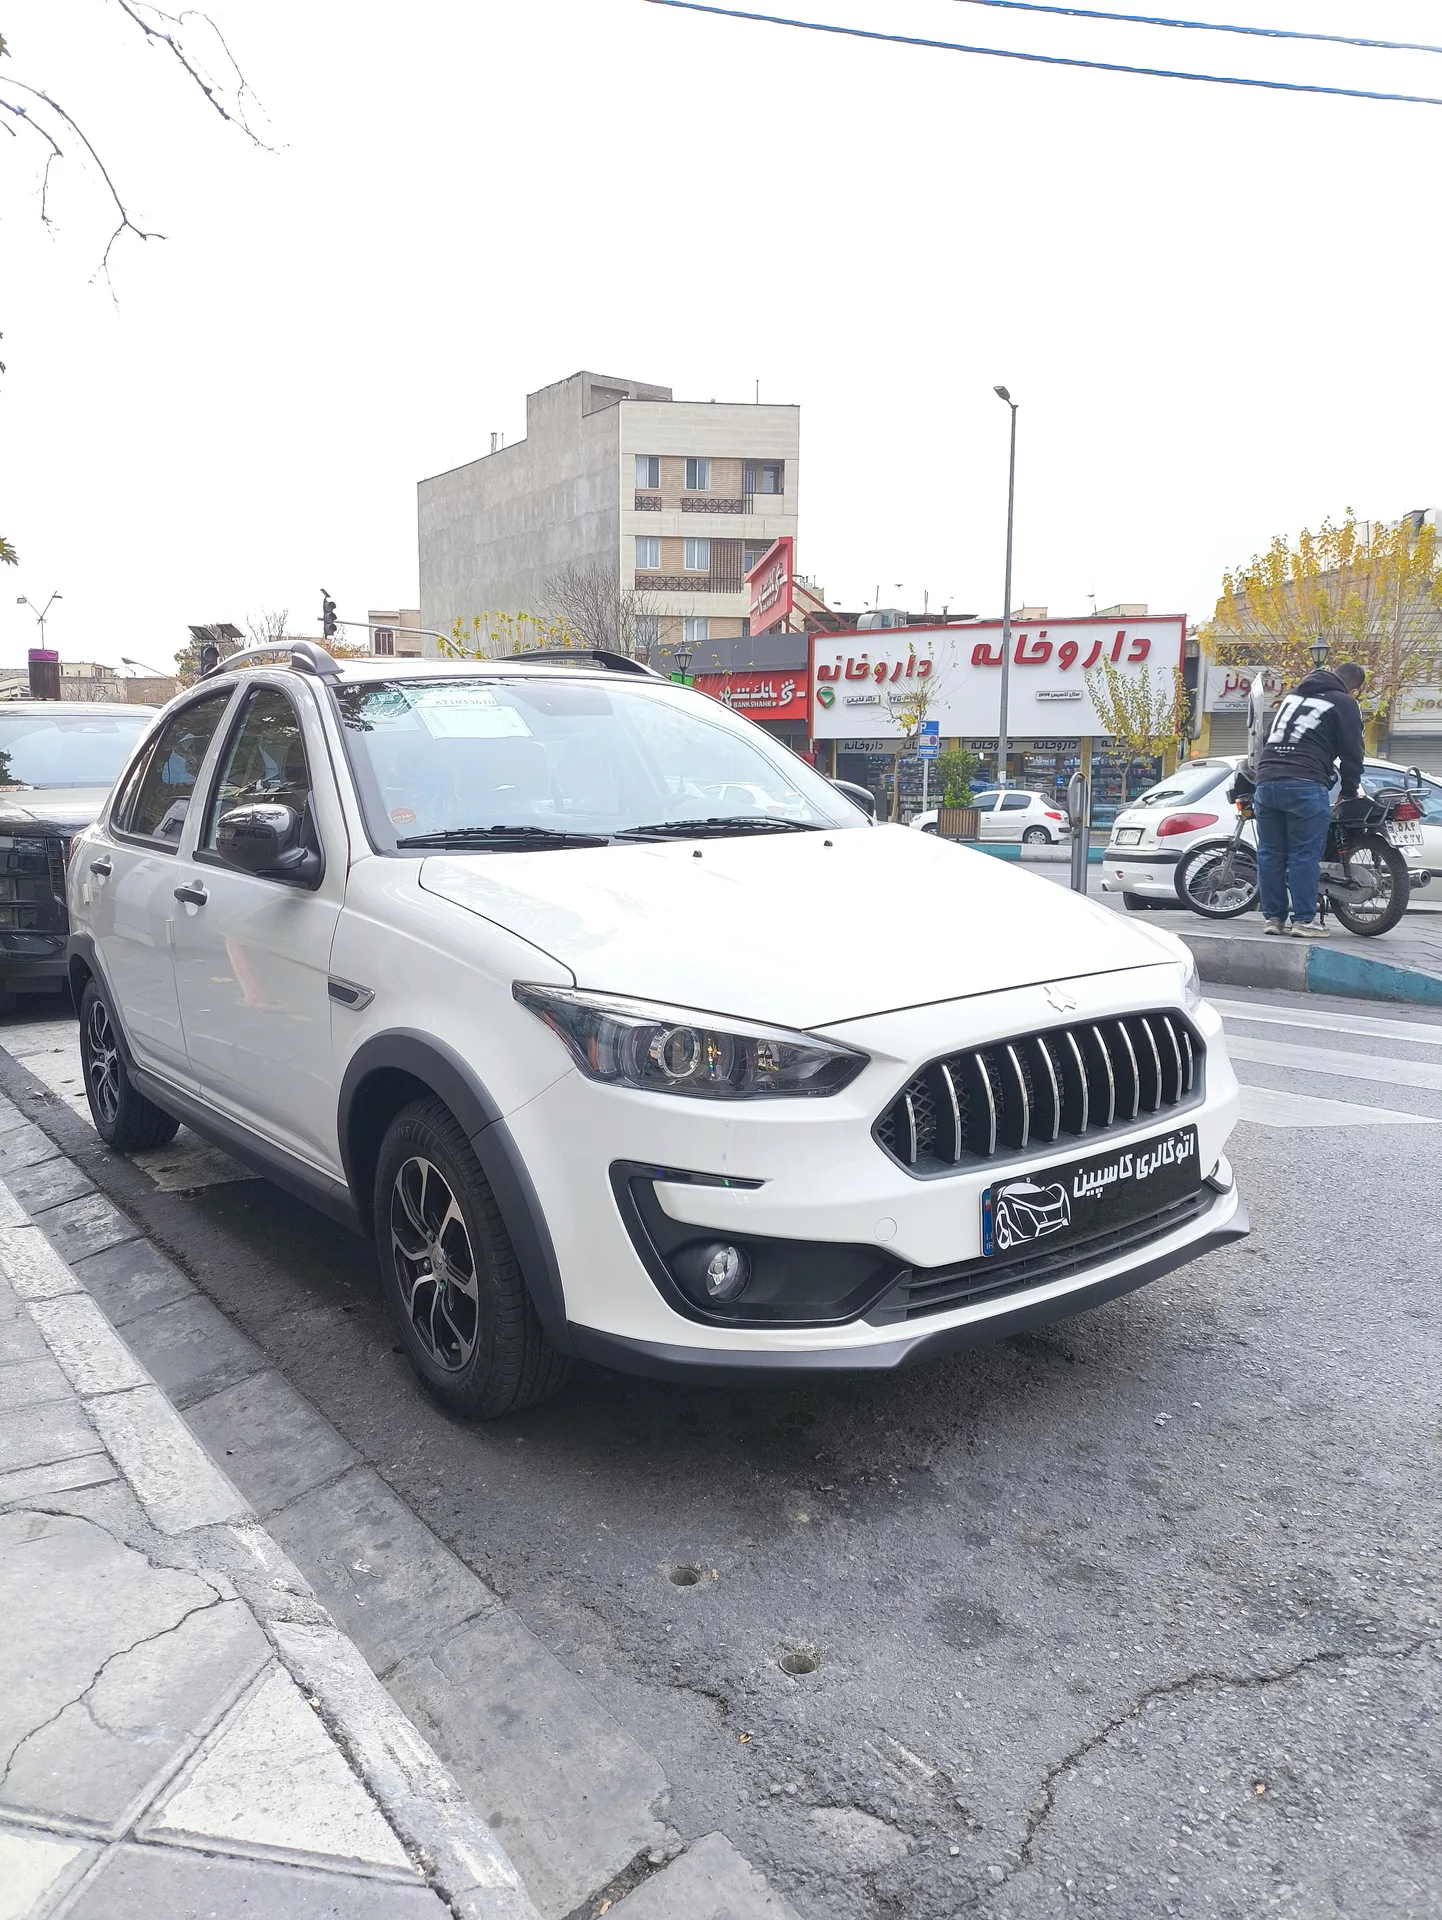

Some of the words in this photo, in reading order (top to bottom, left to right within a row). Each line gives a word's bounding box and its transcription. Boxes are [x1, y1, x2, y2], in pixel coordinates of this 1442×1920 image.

[970, 630, 1152, 671] داروخاه
[816, 653, 933, 684] داروخانه
[920, 722, 927, 733] P
[844, 740, 884, 751] داروخانه
[1033, 741, 1078, 751] داروخانه
[1073, 1153, 1134, 1199] کاسپین
